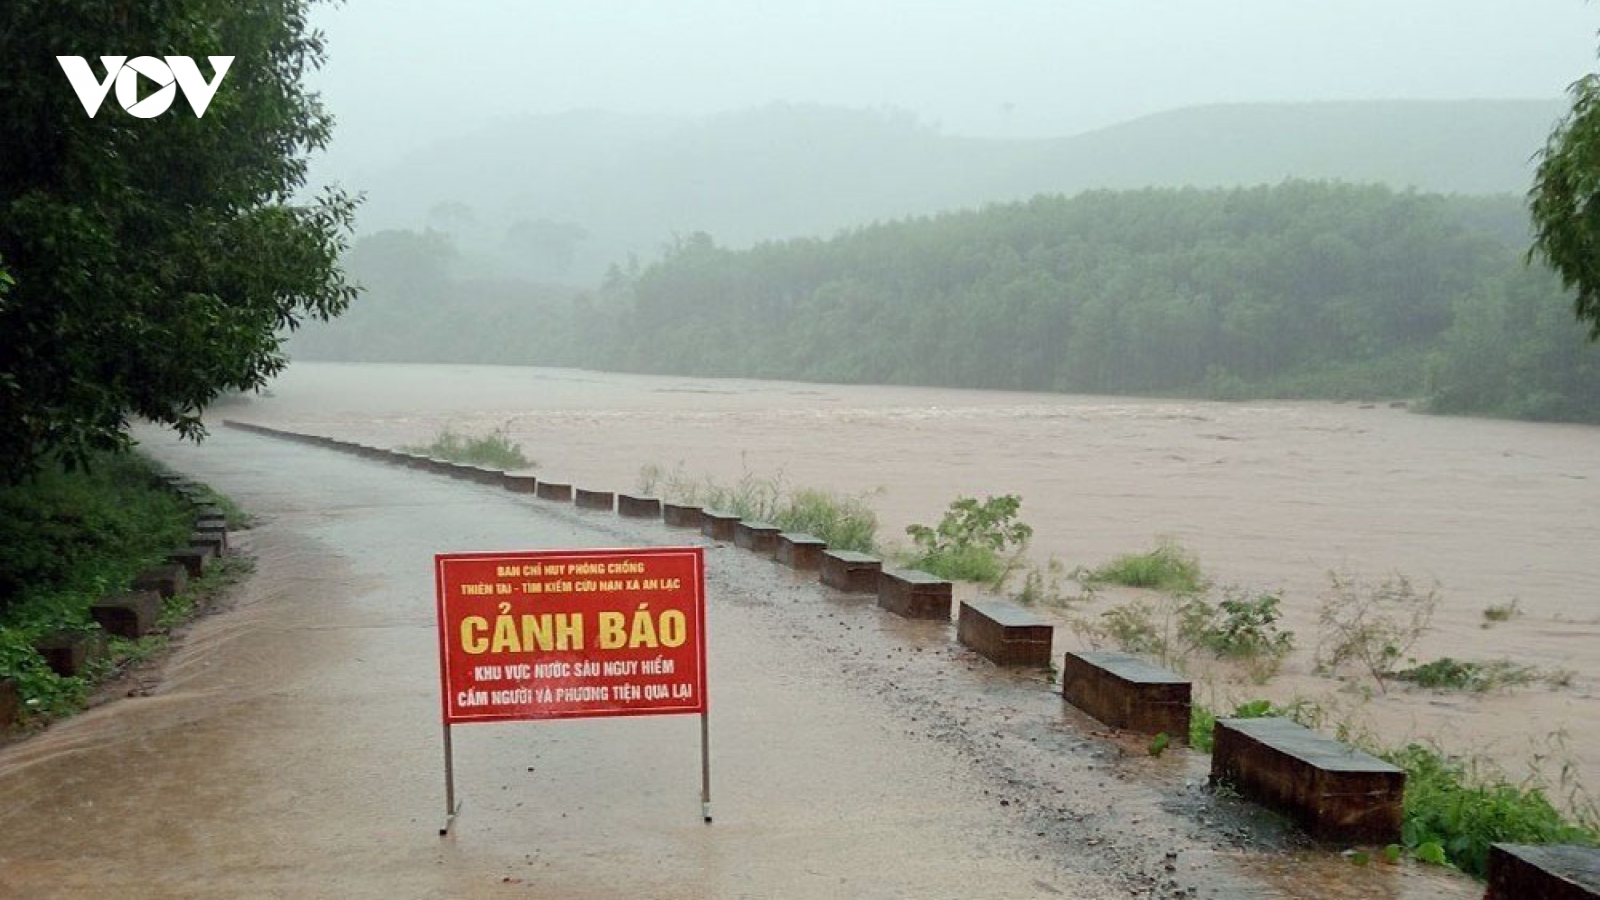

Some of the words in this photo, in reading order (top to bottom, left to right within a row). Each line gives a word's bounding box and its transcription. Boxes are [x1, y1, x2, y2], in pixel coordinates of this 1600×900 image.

[497, 565, 521, 576] BAN
[523, 562, 542, 576] CHỈ
[544, 565, 565, 575] HUY
[567, 562, 606, 575] PHÒNG
[607, 559, 645, 574] CHỐNG
[461, 581, 494, 595] THIÊN
[496, 583, 512, 594] TAI
[544, 578, 572, 592] KIẾM
[642, 580, 659, 590] AN
[660, 578, 681, 592] LẠC
[460, 602, 584, 654] CẢNH
[598, 602, 687, 649] BÁO
[474, 665, 502, 681] KHU
[504, 663, 531, 682] VỰC
[534, 660, 571, 678] NƯỚC
[573, 659, 601, 677] SÂU
[603, 659, 638, 675] NGUY
[458, 685, 489, 707] CẤM
[491, 685, 532, 705] NGƯỜI
[535, 685, 553, 703] VÀ
[556, 686, 609, 702] PHƯƠNG
[612, 682, 641, 703] TIỆN
[644, 684, 670, 700] QUA
[672, 683, 692, 701] LẠI
